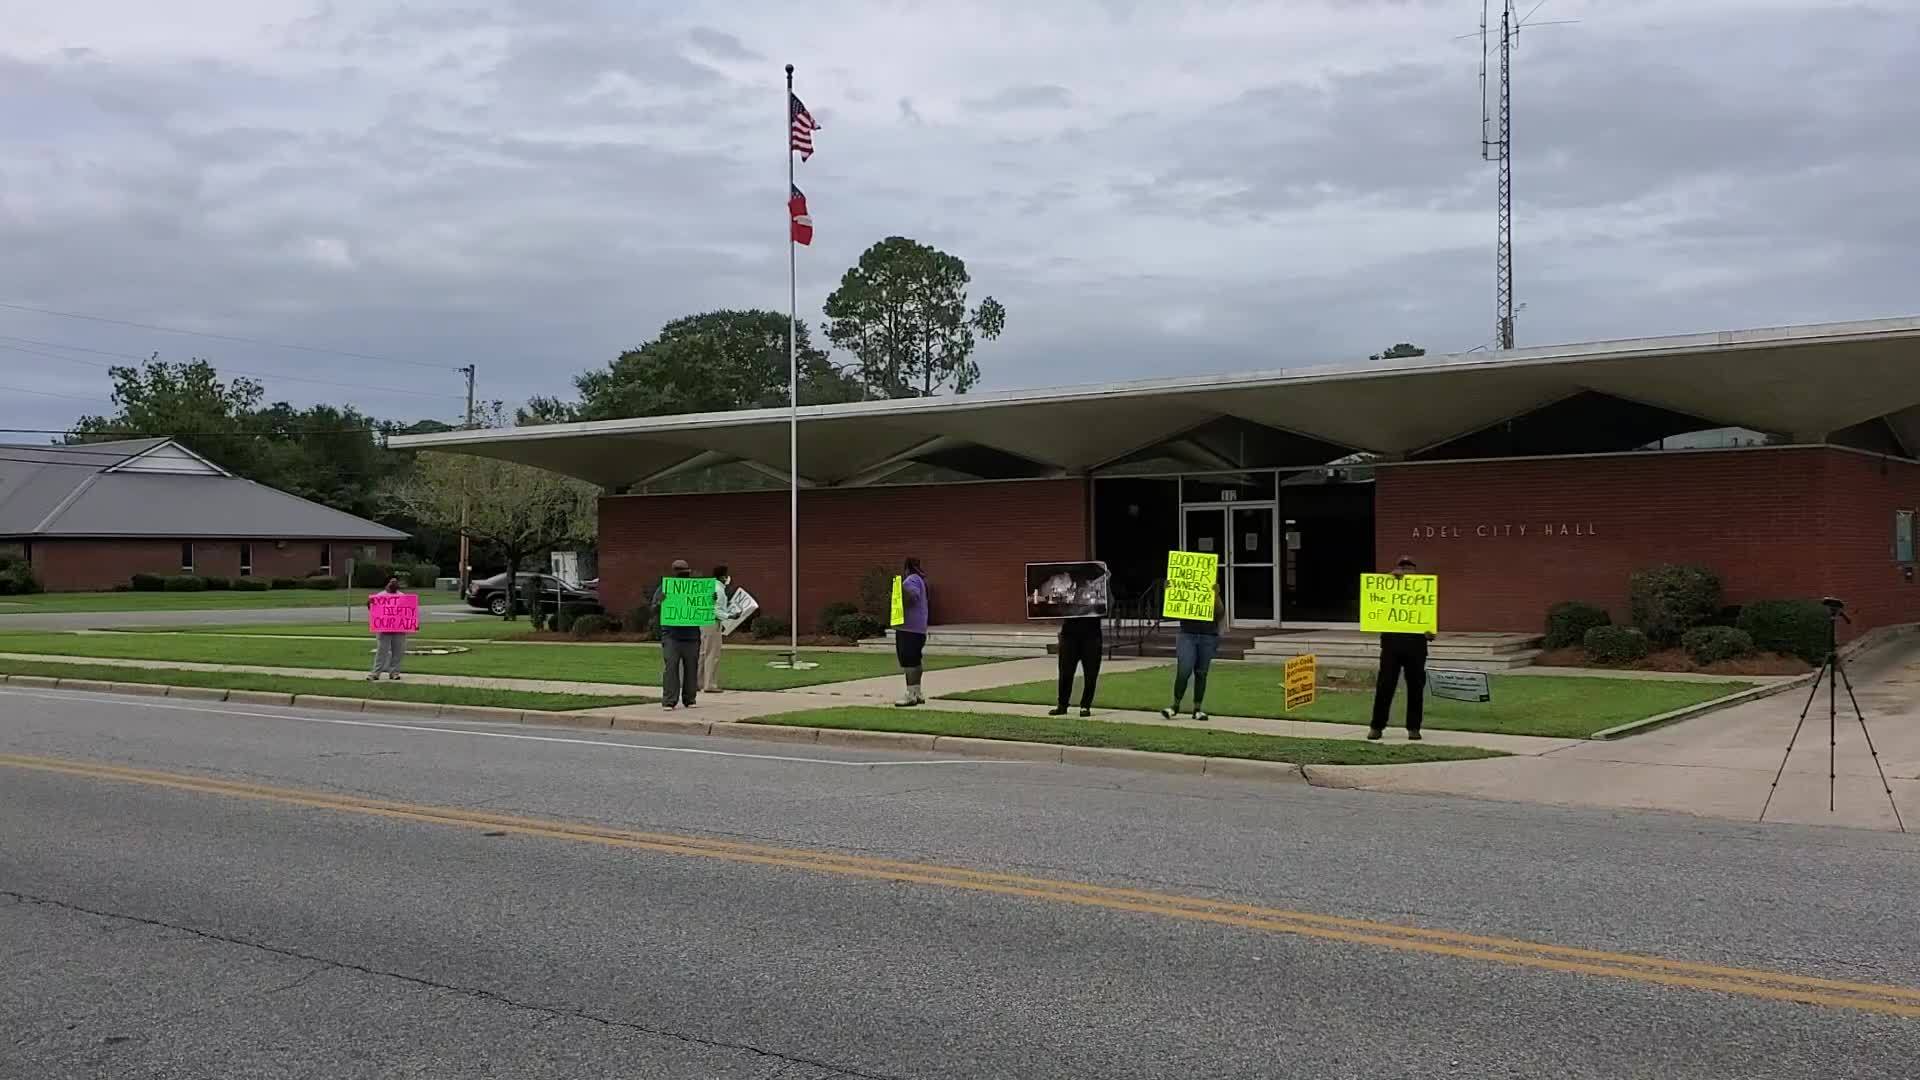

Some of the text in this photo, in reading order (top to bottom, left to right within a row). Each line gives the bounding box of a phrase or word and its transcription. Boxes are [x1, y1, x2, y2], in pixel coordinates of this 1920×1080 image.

[1412, 523, 1596, 538] ADEL CITY HALL
[1169, 553, 1216, 571] GOOD FOR
[1169, 567, 1211, 583] TIMBER
[1366, 576, 1434, 593] PROTECT
[734, 591, 751, 609] NO
[1168, 589, 1212, 604] BAD FOR
[1369, 592, 1435, 606] the PEOPLE
[1184, 603, 1212, 618] HEALTH
[1388, 607, 1430, 625] ADEL
[373, 617, 417, 630] OUR AIR
